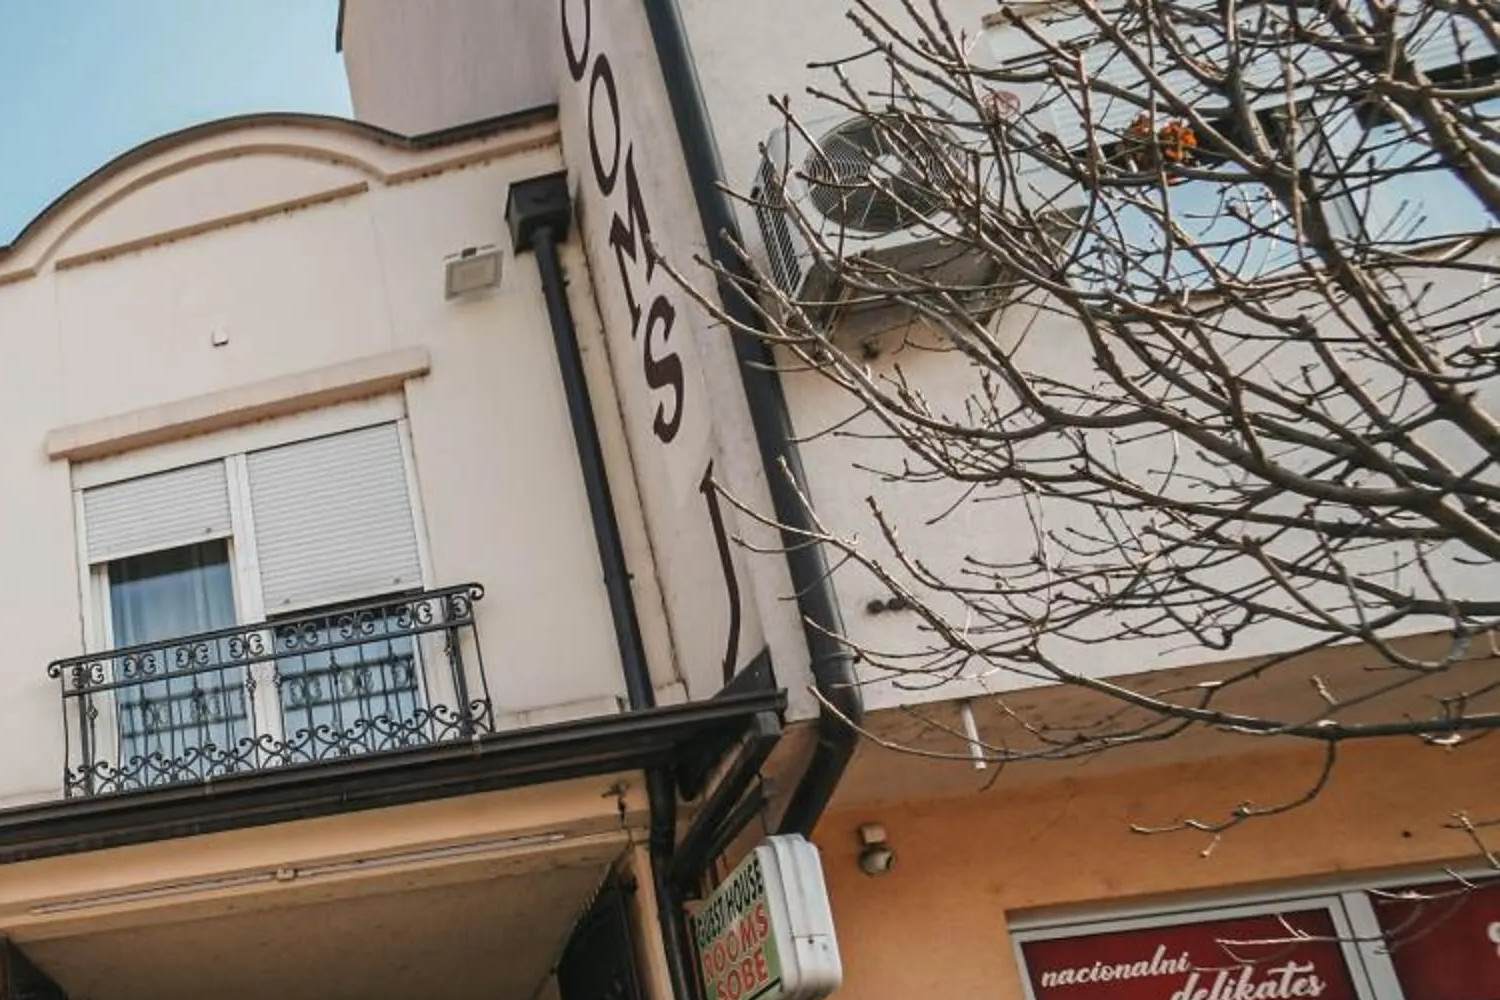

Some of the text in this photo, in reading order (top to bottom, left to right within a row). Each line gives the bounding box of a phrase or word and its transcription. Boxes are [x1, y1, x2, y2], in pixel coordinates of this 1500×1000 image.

[697, 856, 765, 948] GUEST HOUSE
[703, 903, 770, 984] ROOMS
[1041, 943, 1192, 989] nacionalni
